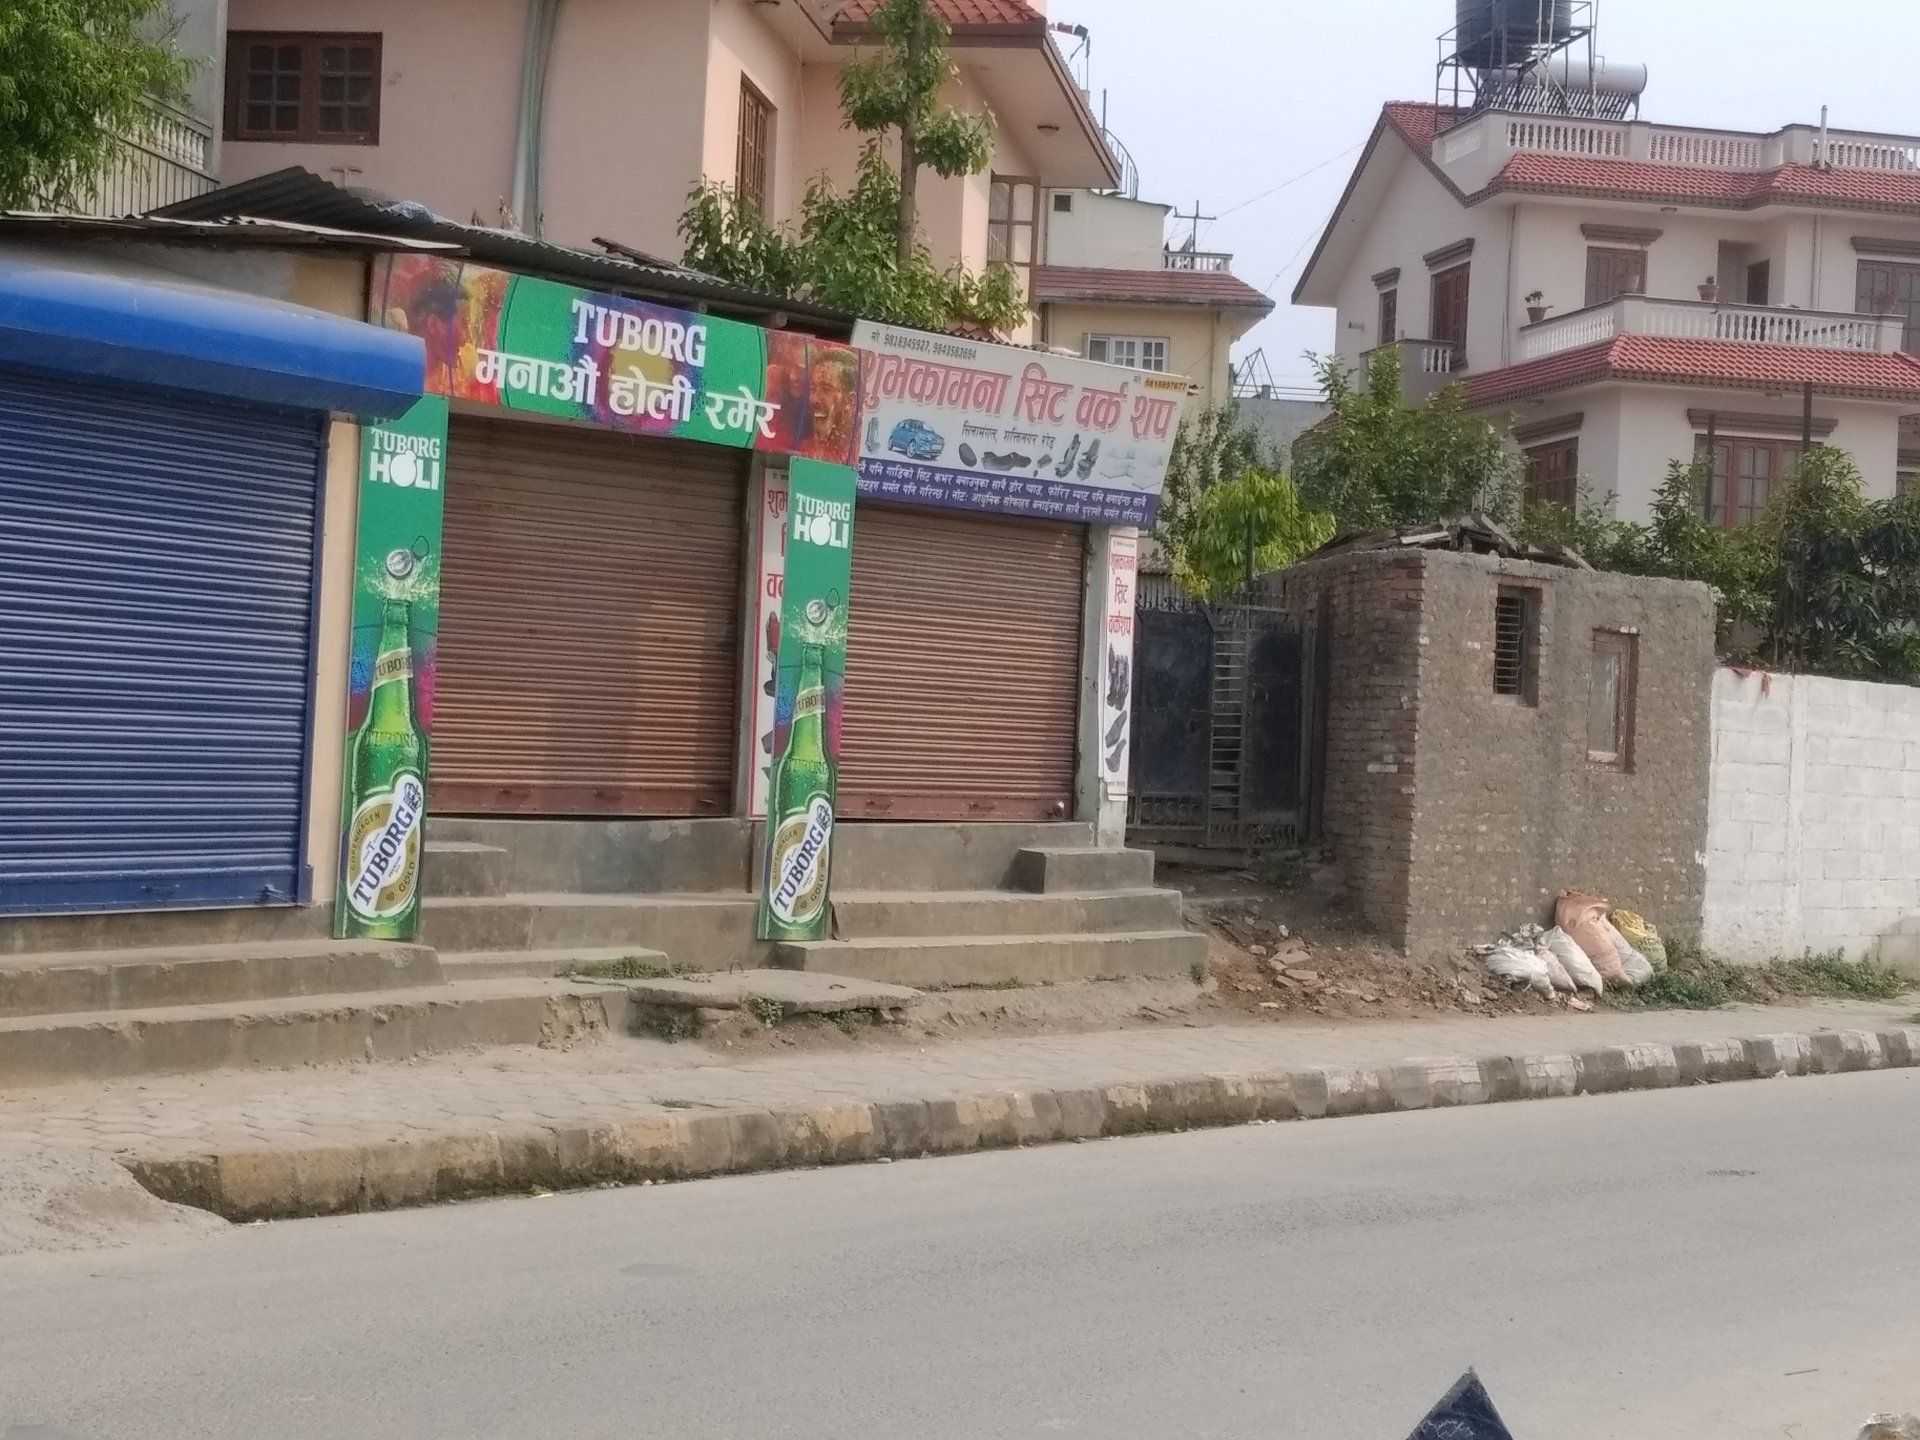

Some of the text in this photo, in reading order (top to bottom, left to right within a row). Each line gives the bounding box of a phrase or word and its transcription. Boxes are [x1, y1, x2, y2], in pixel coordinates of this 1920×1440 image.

[572, 299, 708, 368] TUBORG
[608, 365, 697, 423] होली
[705, 386, 781, 439] रमेर
[1013, 362, 1074, 423] सिट
[1076, 382, 1128, 430] वर्क
[1130, 396, 1177, 440] शप
[371, 427, 440, 459] TUBORG
[796, 493, 850, 521] TUBORG
[353, 805, 414, 907] TUBORG
[398, 861, 415, 892] GOLD
[774, 824, 824, 912] TUBORG
[810, 874, 824, 901] GOLD
